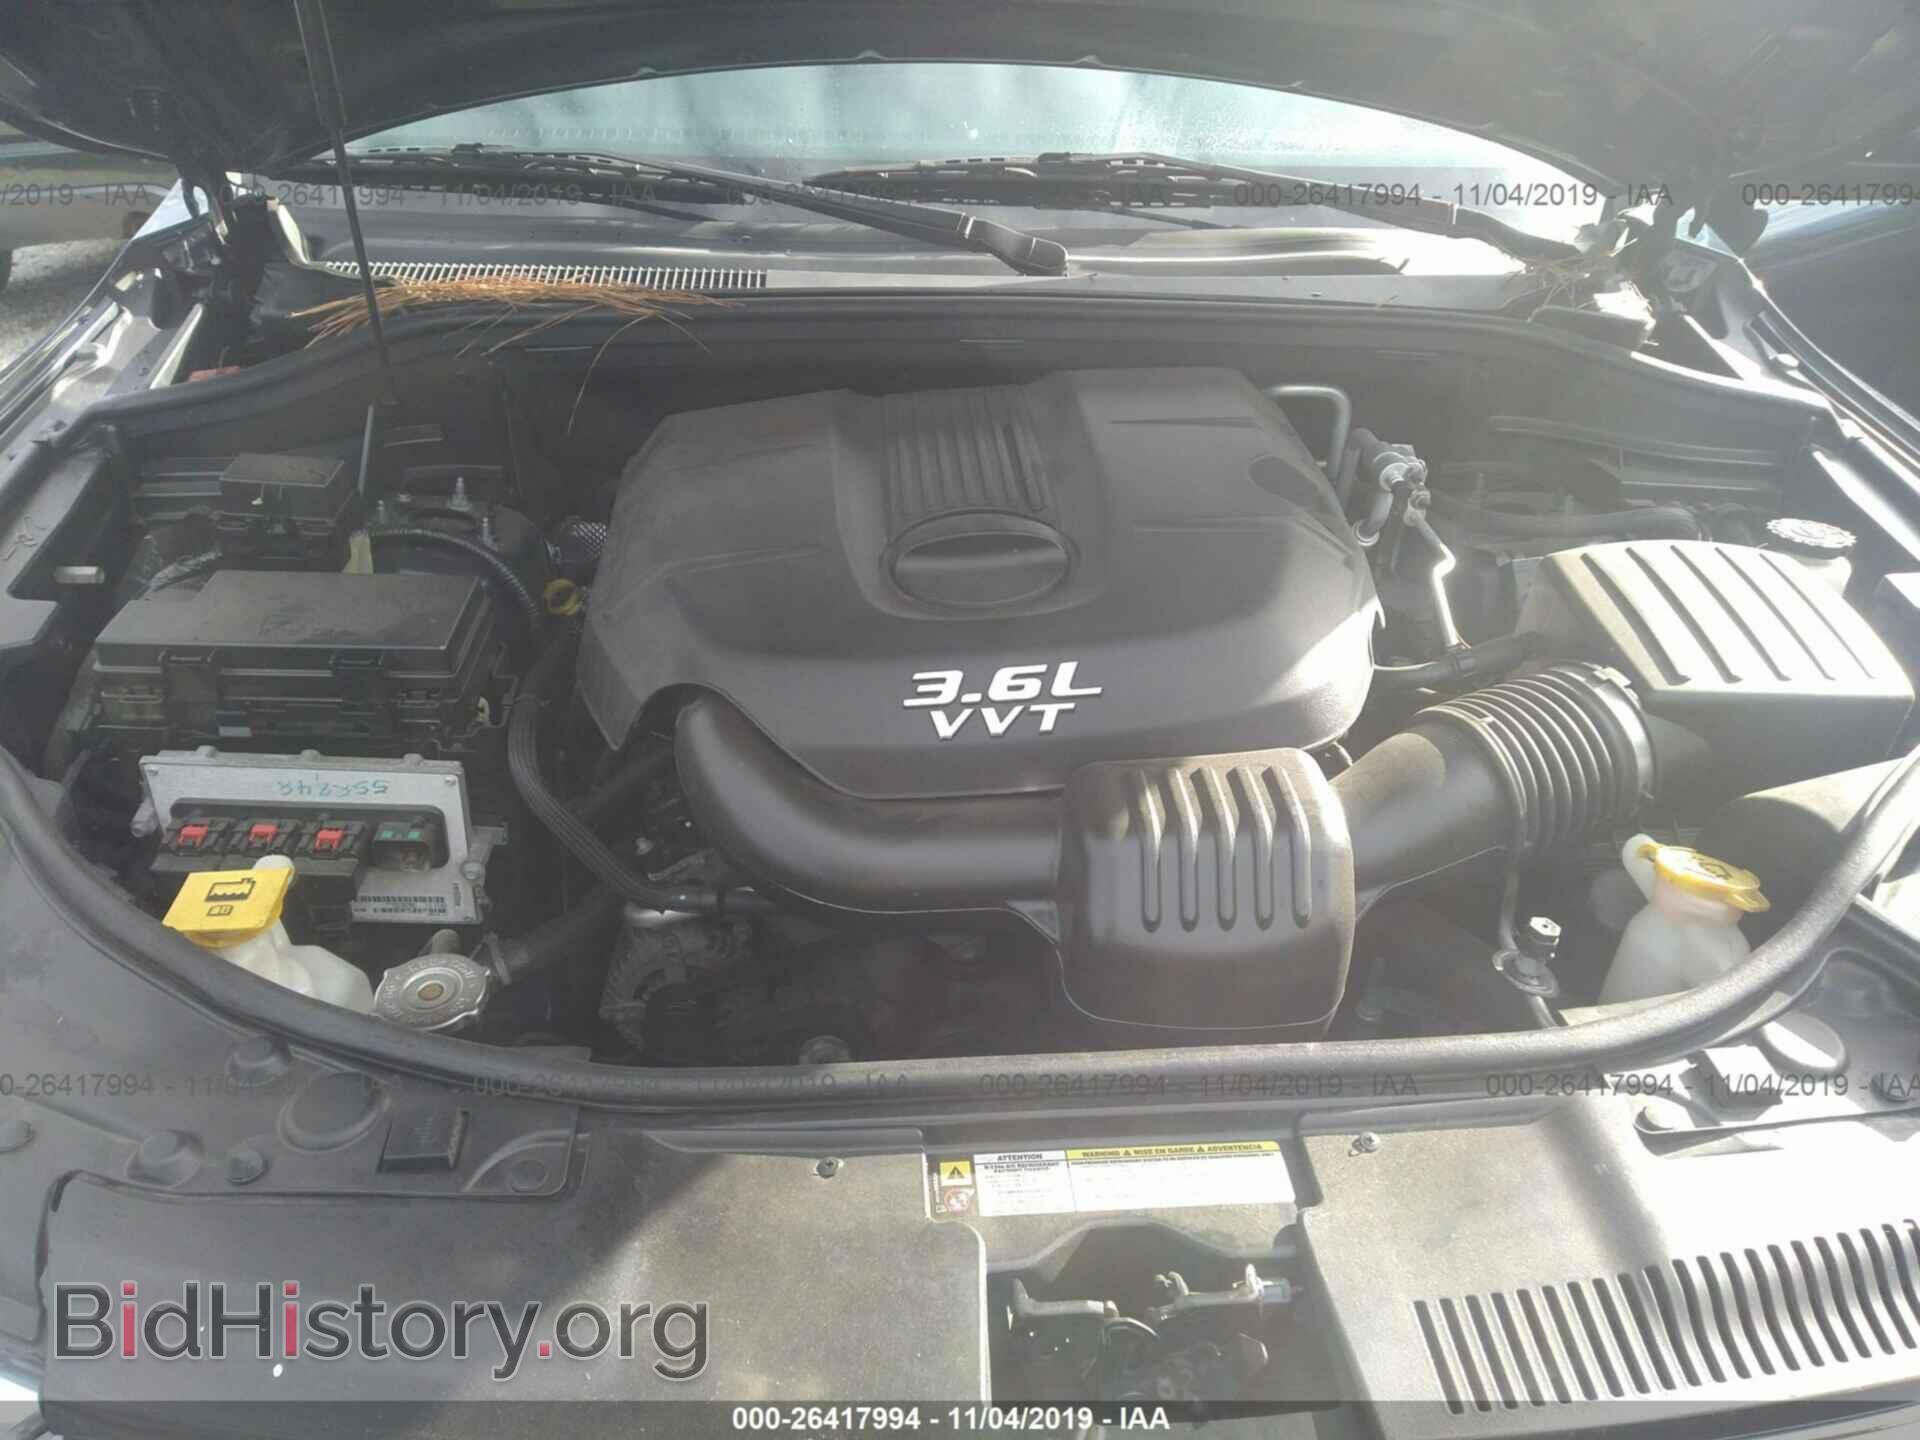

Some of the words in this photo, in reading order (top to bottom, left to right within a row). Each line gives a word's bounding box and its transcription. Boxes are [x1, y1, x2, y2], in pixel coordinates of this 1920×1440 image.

[903, 661, 1103, 708] 3.6L
[930, 703, 1076, 740] VVT
[997, 1153, 1043, 1161] ATTENTION
